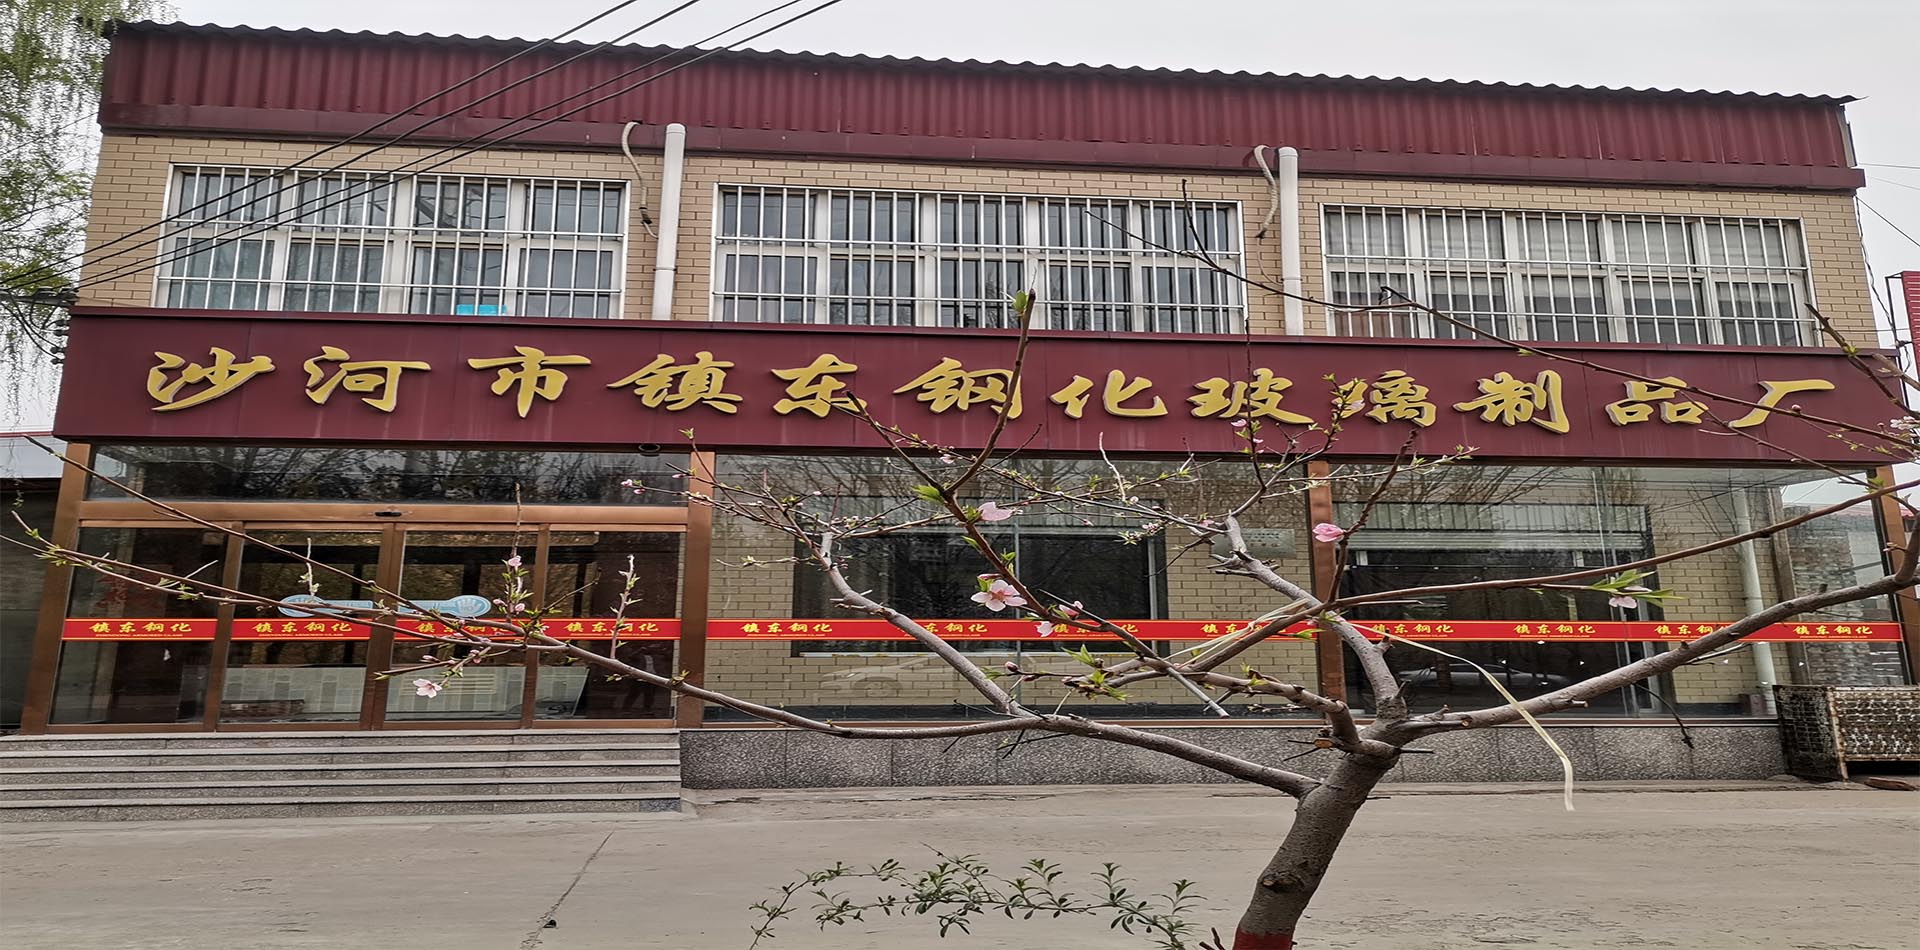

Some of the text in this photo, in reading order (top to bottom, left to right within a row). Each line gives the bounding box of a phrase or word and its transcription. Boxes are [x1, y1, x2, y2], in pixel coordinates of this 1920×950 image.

[147, 346, 1834, 434] 沙河市镇东钢化玻璃制品厂
[1052, 623, 1138, 632] 镇化
[1654, 625, 1738, 634] 镇东钢
